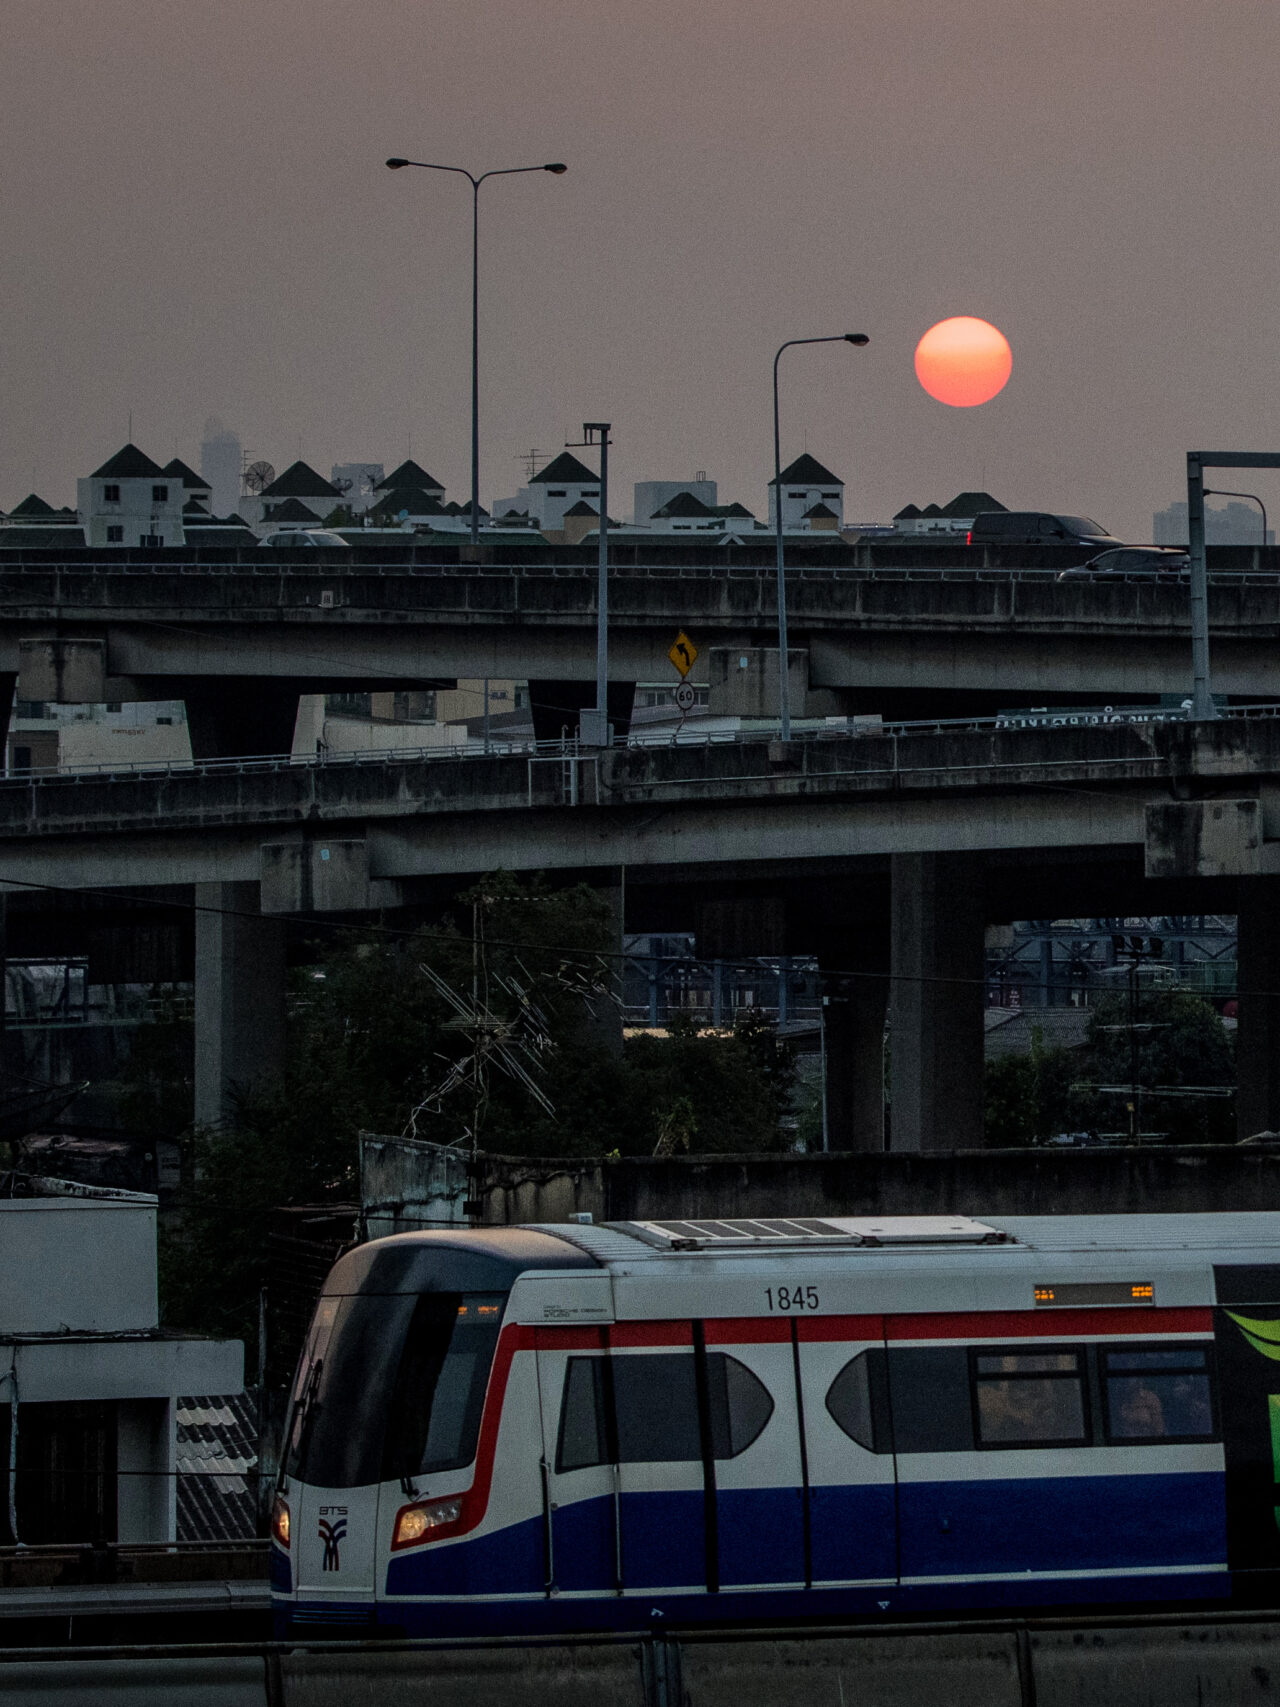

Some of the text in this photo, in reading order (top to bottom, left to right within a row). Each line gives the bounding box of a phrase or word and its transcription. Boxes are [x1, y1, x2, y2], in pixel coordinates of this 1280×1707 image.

[679, 691, 692, 702] 60
[764, 1286, 819, 1311] 1845
[319, 1506, 348, 1516] BTS
